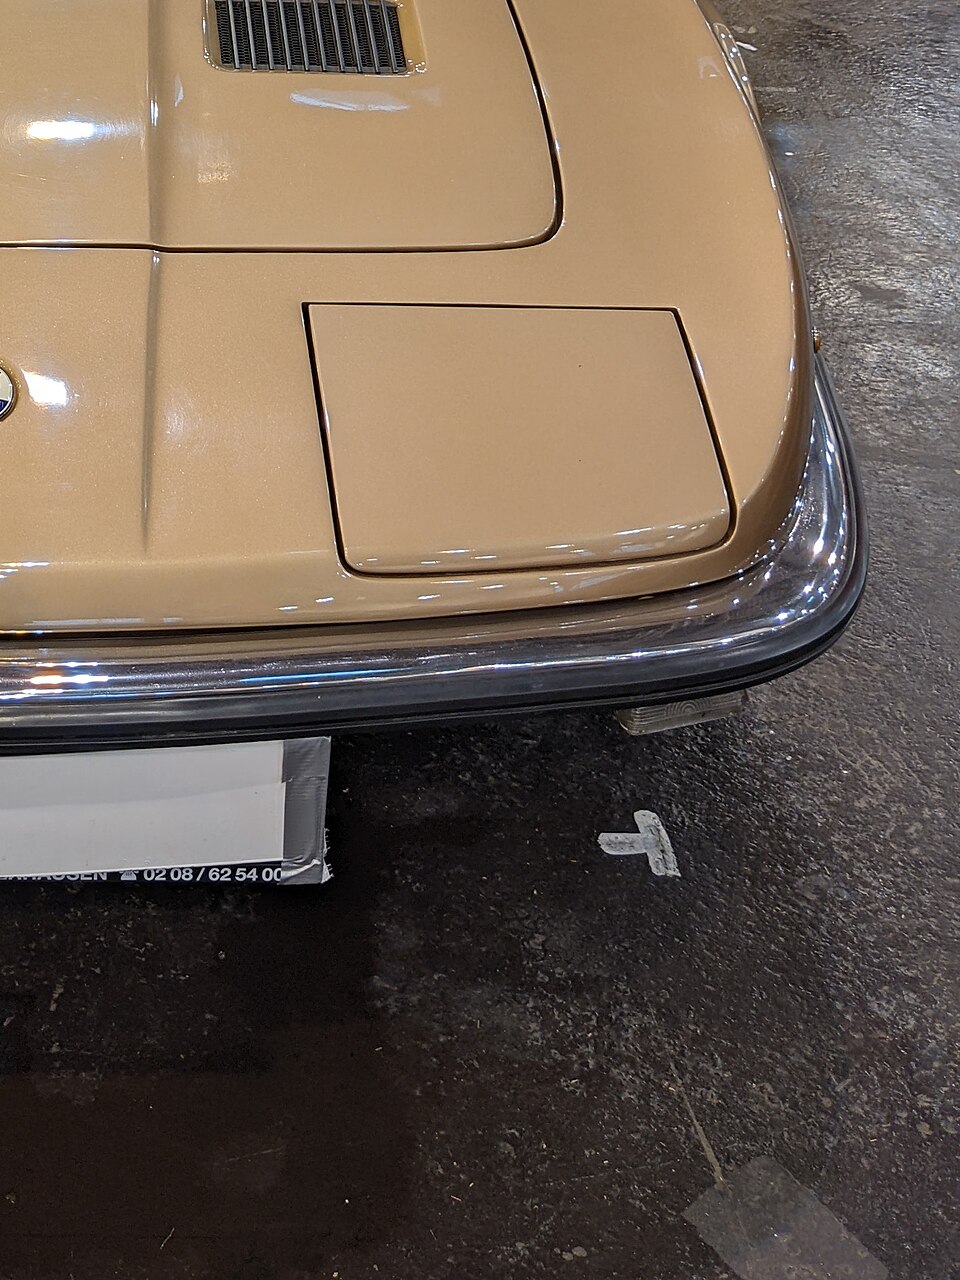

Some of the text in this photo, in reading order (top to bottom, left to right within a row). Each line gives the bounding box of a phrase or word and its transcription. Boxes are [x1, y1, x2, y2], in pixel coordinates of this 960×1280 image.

[143, 867, 167, 881] 02
[170, 867, 194, 881] 08
[208, 867, 232, 881] 62
[235, 867, 259, 881] 54
[262, 867, 282, 881] 00
